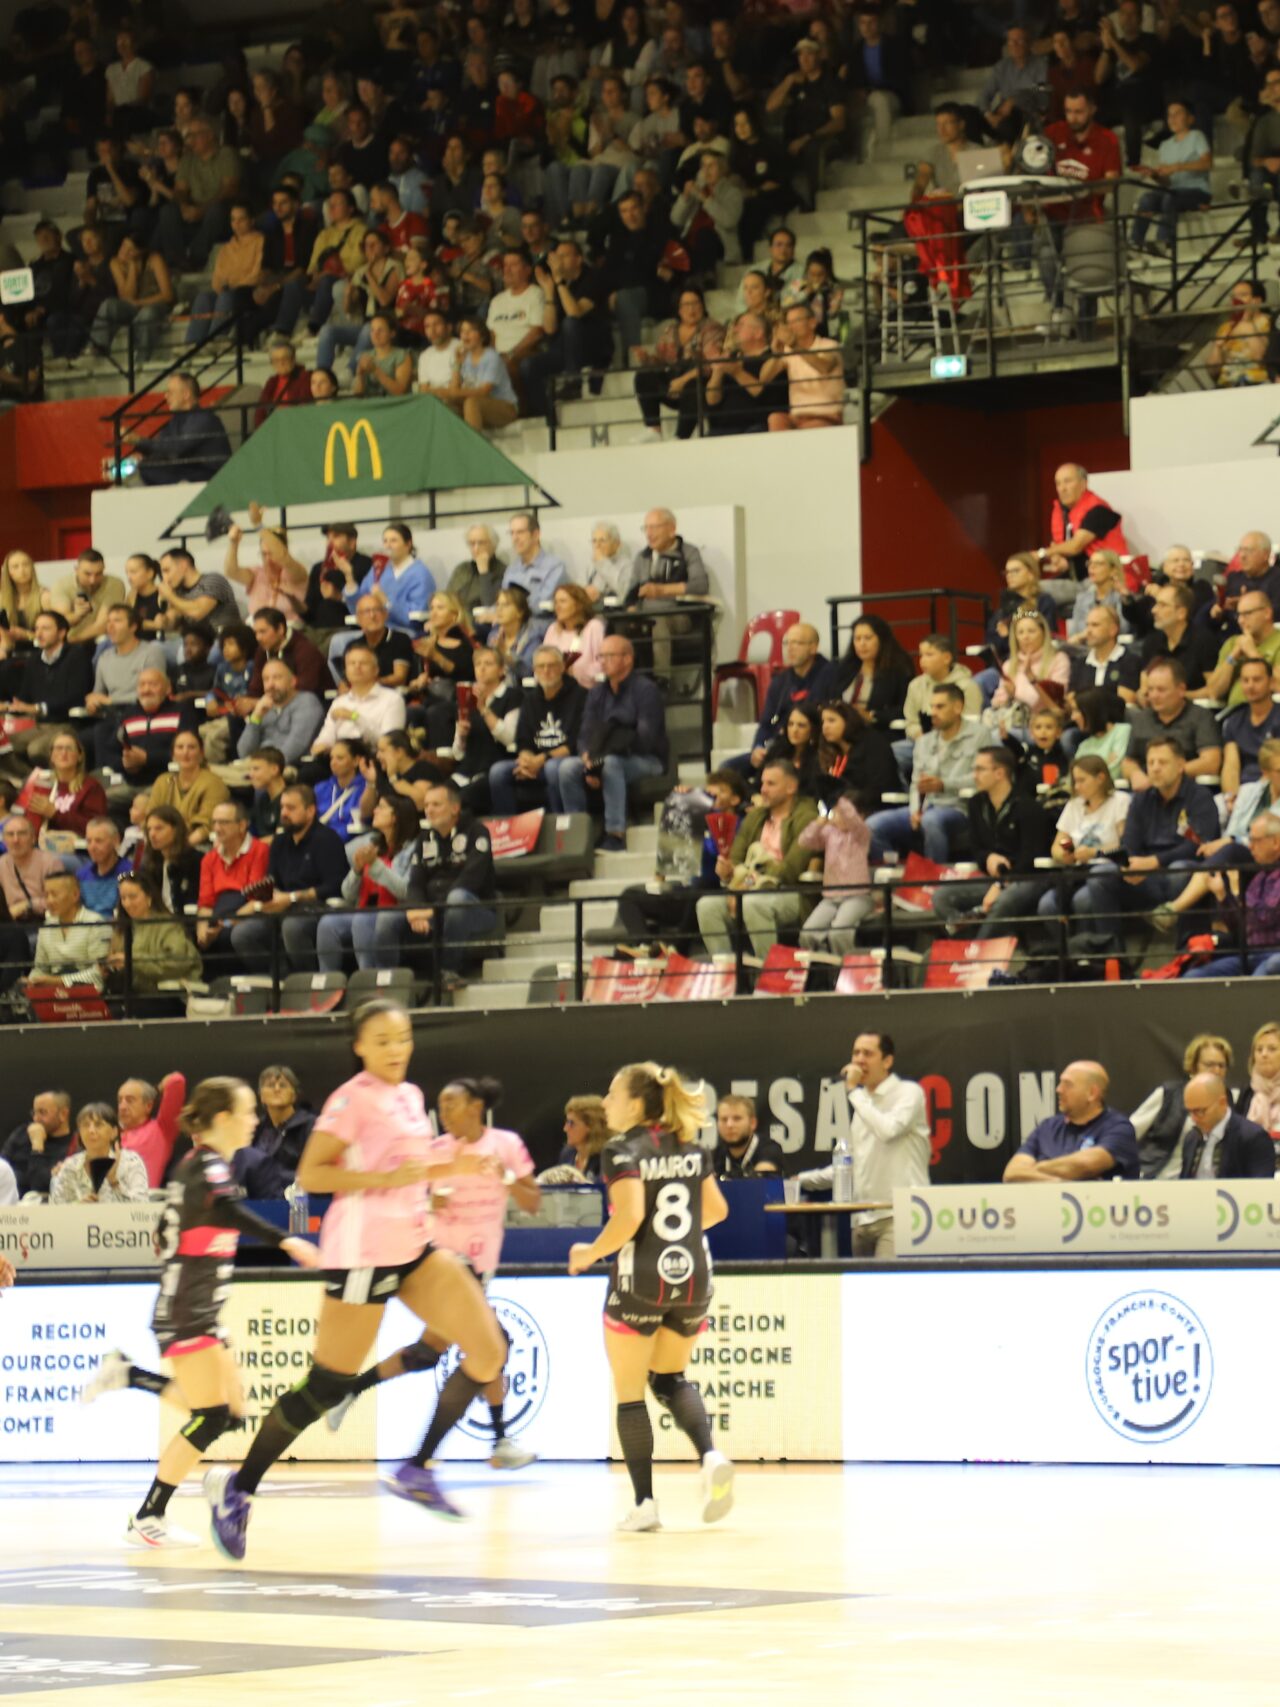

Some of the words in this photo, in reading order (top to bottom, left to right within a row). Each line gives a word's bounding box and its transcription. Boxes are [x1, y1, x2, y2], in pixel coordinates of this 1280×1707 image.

[640, 1154, 702, 1181] MAIROT
[652, 1183, 692, 1242] 8
[912, 1195, 1016, 1246] Doubs
[1062, 1192, 1170, 1244] Doubs
[5, 1384, 84, 1402] FRANCH
